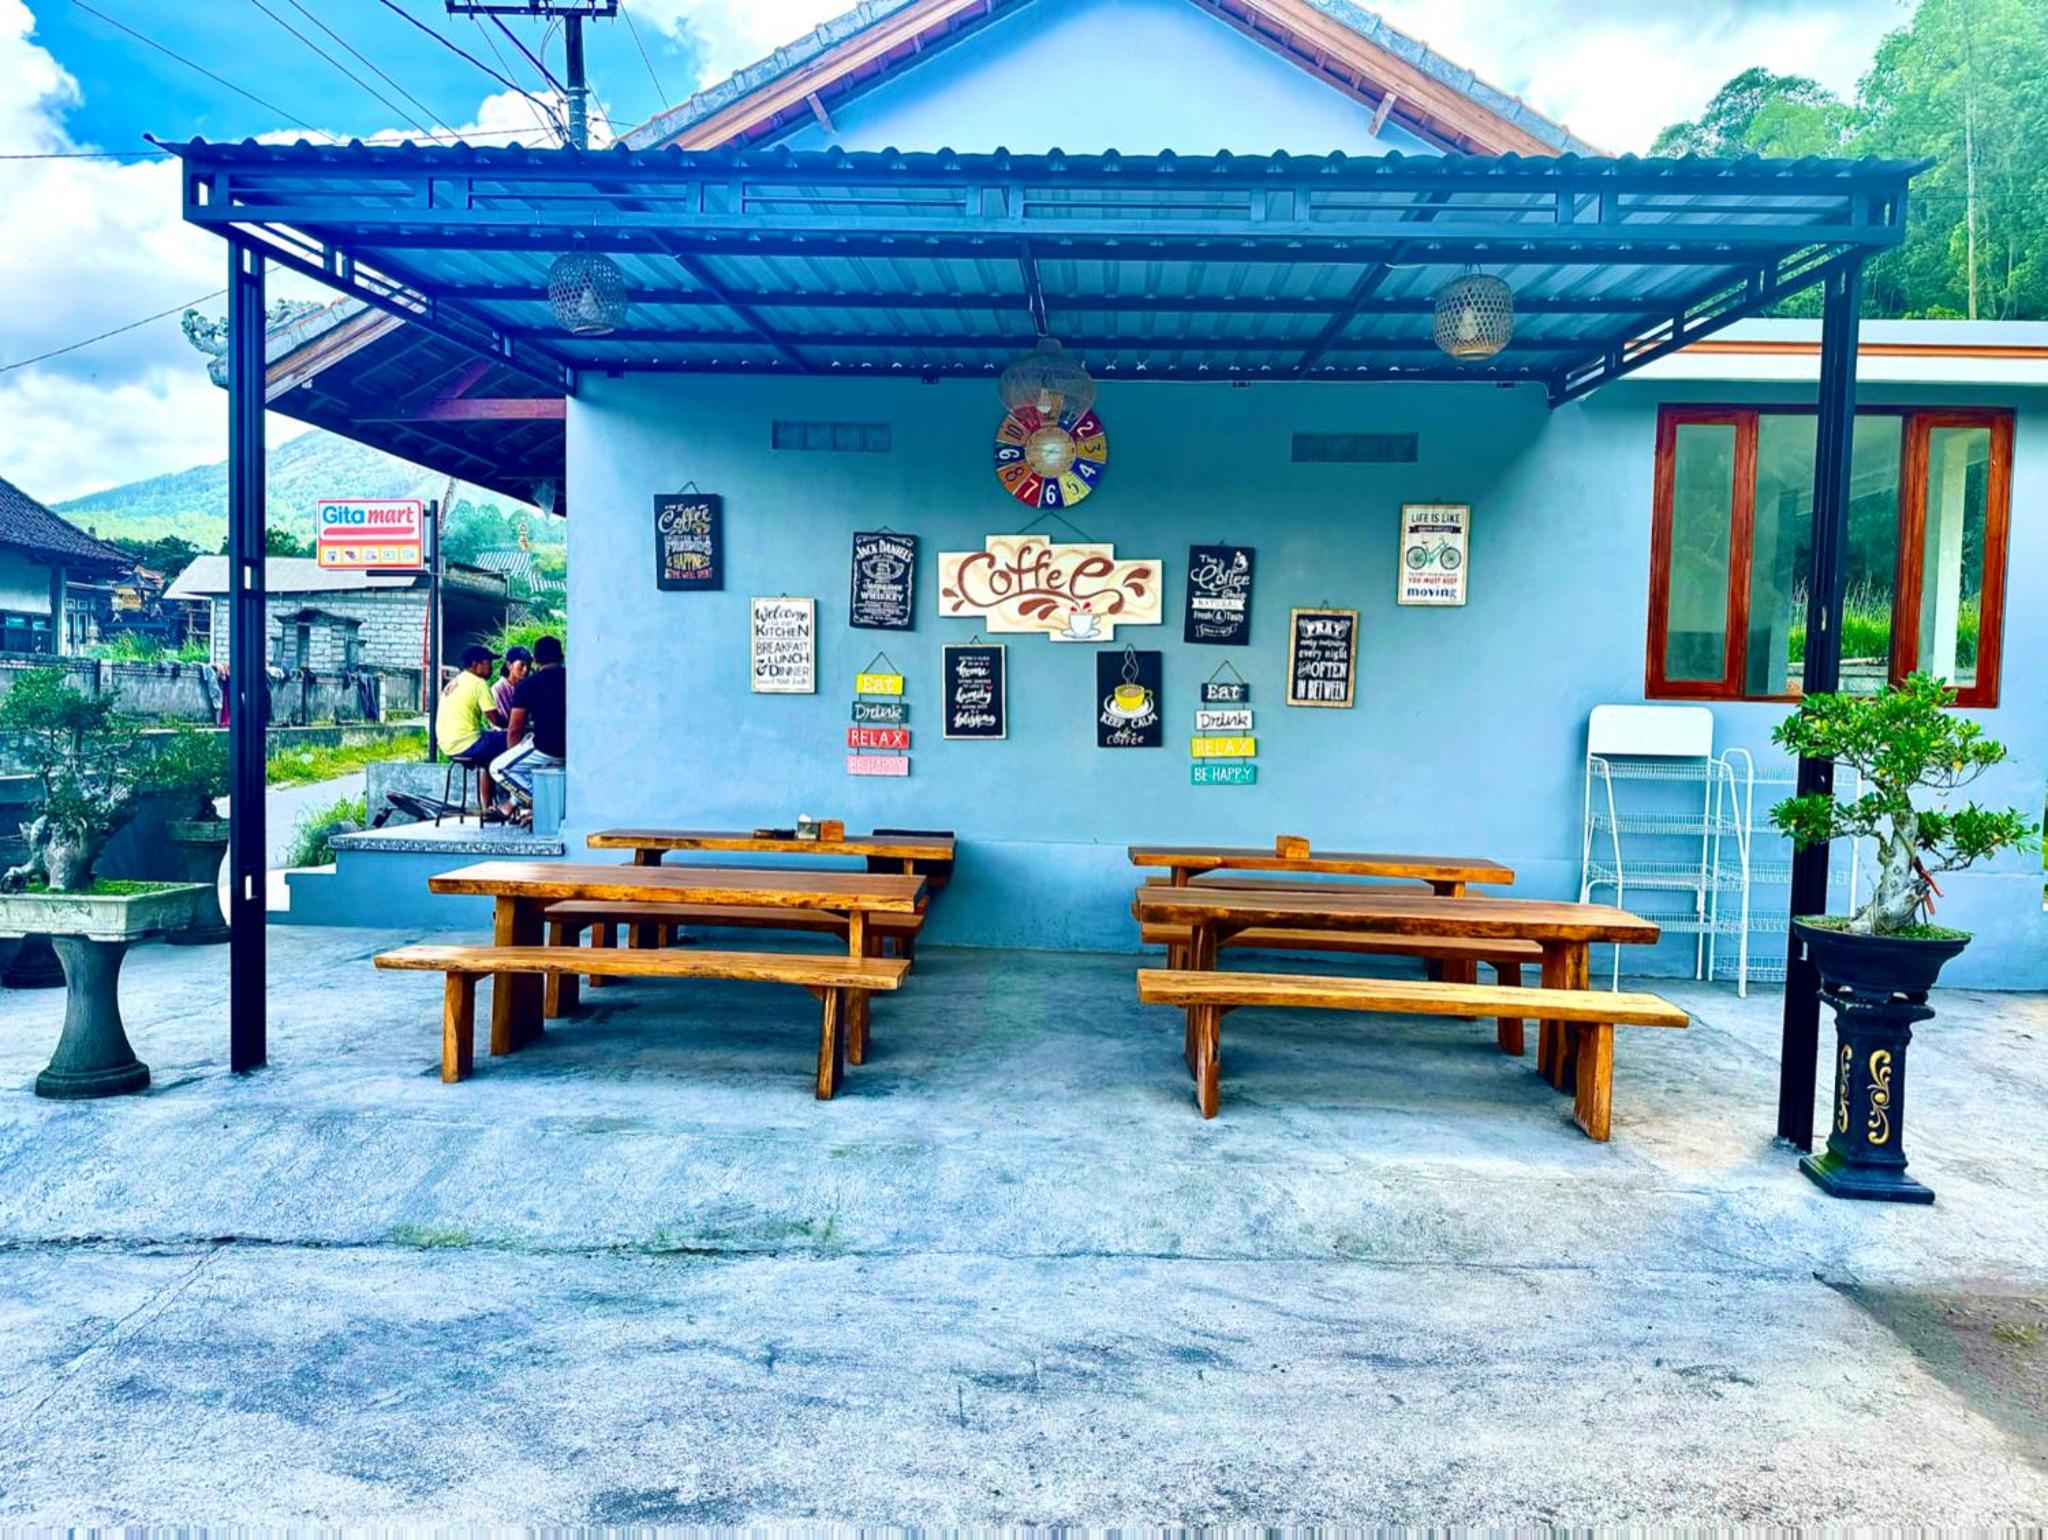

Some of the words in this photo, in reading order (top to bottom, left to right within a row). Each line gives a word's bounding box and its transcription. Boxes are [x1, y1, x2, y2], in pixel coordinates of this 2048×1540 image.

[1004, 423, 1025, 441] 10
[1077, 421, 1095, 438] 2
[999, 448, 1020, 460] 9
[1006, 466, 1025, 482] 8
[1079, 464, 1096, 478] 4
[1023, 478, 1039, 500] 7
[1046, 484, 1057, 505] 6
[323, 506, 365, 524] Gita
[367, 506, 415, 524] mart
[658, 505, 713, 534] Coffee
[1411, 513, 1428, 523] LIFE
[1431, 513, 1440, 523] IS
[1442, 513, 1460, 523] LIKE
[856, 543, 878, 560] JACK
[957, 546, 1125, 614] Coffee
[1190, 562, 1250, 591] Coffee
[860, 591, 904, 602] WHISKEY
[1407, 586, 1457, 600] moving
[755, 605, 808, 622] Welcome
[756, 624, 809, 637] KITCHEN
[756, 641, 808, 656] BREAKFAST
[768, 652, 809, 664] LUNCH
[769, 664, 809, 677] DINNER
[1311, 662, 1348, 678] OFTEN
[863, 677, 894, 692] Eat
[1207, 684, 1242, 700] Eat
[1297, 679, 1305, 699] IN
[1307, 679, 1346, 700] BETWEEN
[855, 704, 902, 721] Drink
[1100, 711, 1126, 728] KEEP
[1131, 712, 1159, 729] CALM
[1200, 712, 1248, 729] Drink
[851, 729, 903, 747] RELAX
[1195, 739, 1248, 755] RELAX
[1194, 767, 1207, 781] BE
[1213, 767, 1251, 781] HAPPY
